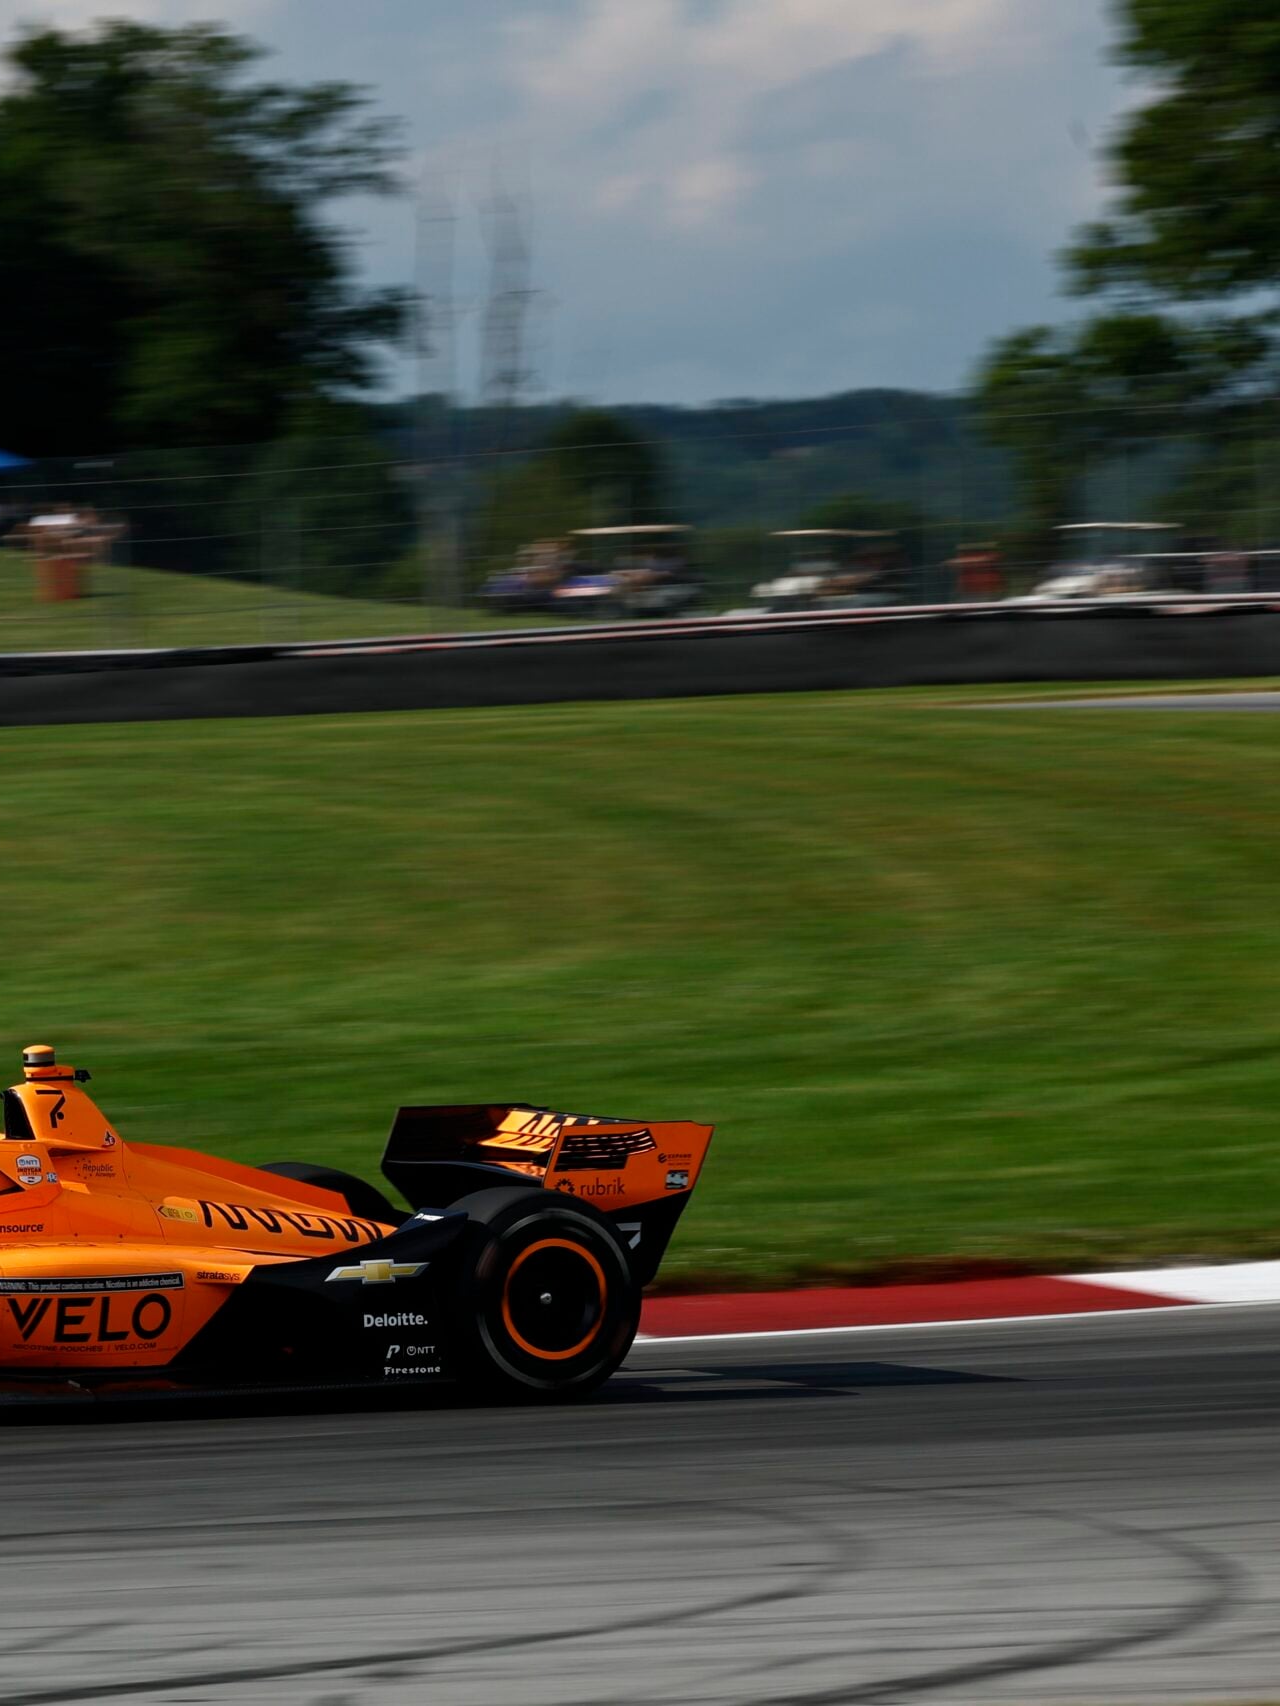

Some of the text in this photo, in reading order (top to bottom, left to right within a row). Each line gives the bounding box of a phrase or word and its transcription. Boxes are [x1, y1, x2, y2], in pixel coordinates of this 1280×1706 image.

[82, 1163, 114, 1173] Republic
[580, 1177, 625, 1195] rubrik
[197, 1271, 240, 1281] stratasys
[7, 1293, 172, 1342] VELO
[363, 1312, 428, 1328] Deloitte.
[114, 1342, 157, 1351] VELO.COM
[417, 1345, 435, 1354] NTT
[384, 1366, 441, 1375] Firestone
